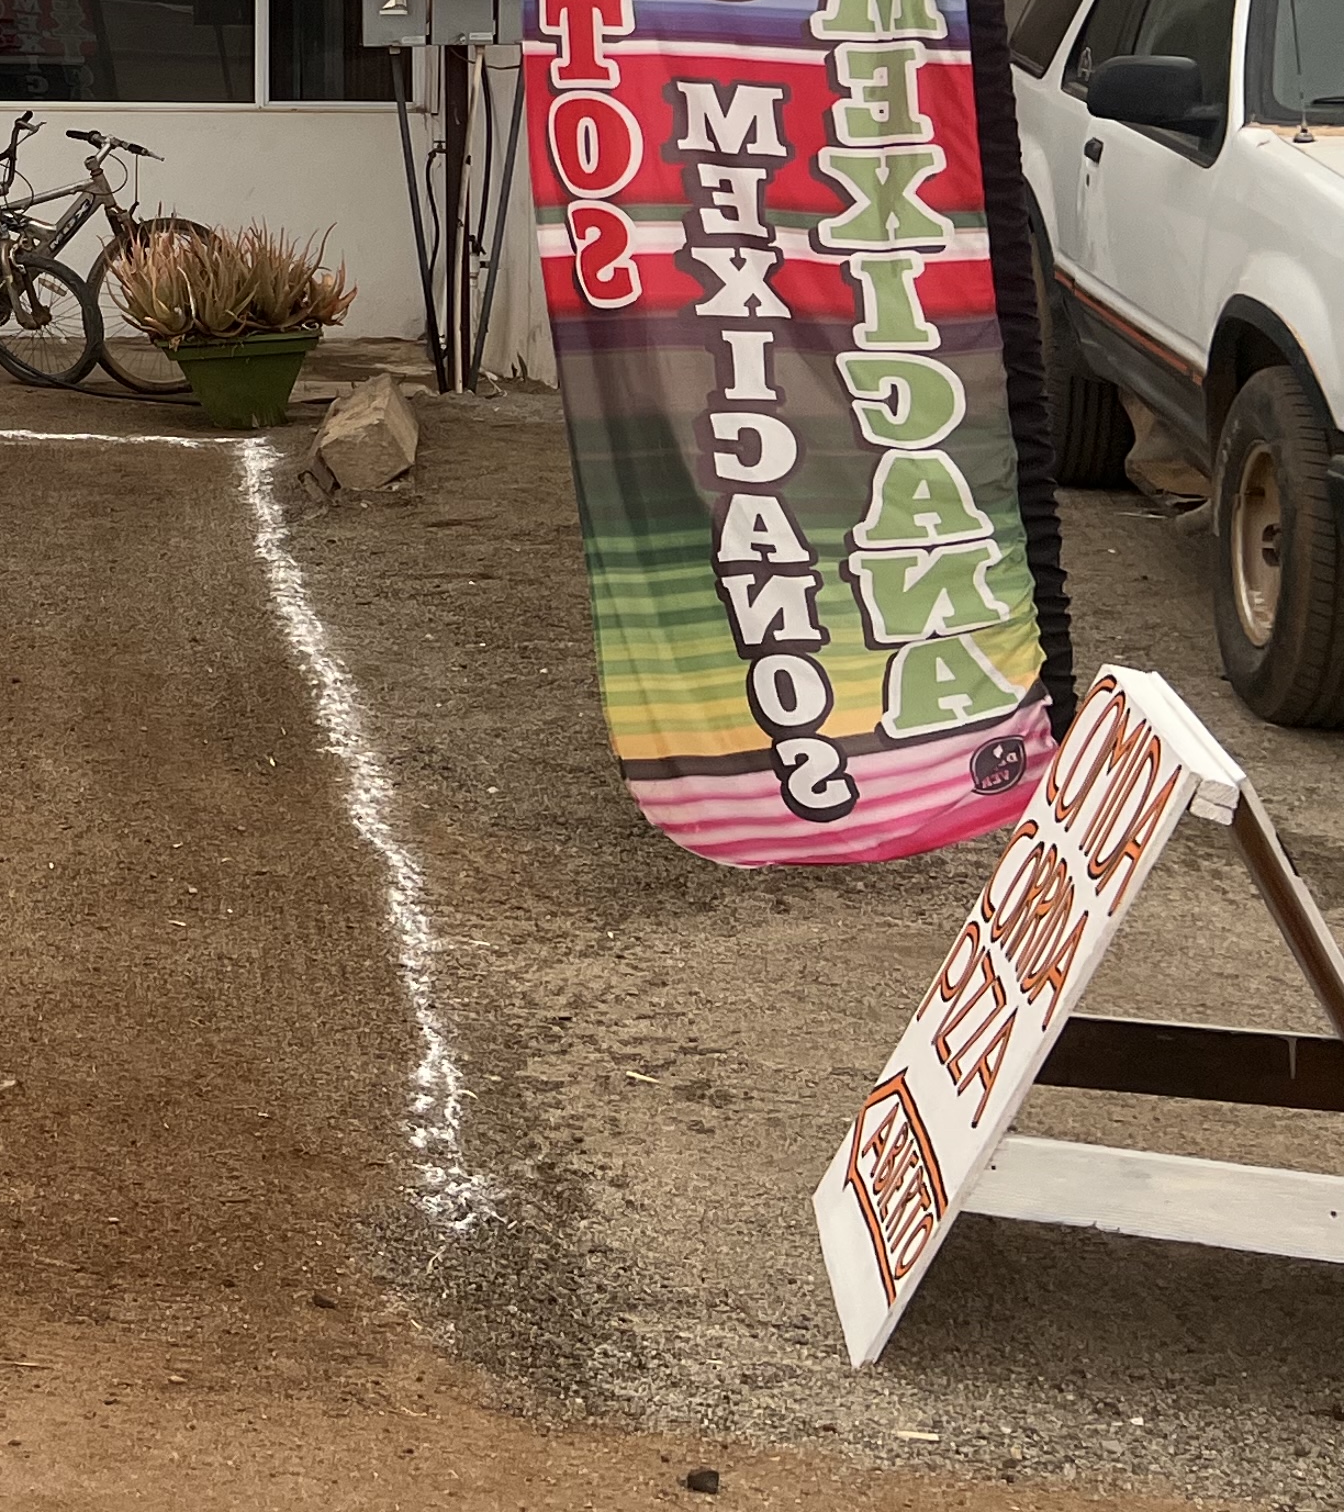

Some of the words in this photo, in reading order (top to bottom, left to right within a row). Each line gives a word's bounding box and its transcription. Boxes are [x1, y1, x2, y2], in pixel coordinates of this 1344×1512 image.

[1046, 675, 1182, 916] COMIDA
[916, 921, 1018, 1127] PIZZA
[981, 819, 1089, 1031] CORRIDA
[861, 1102, 933, 1280] ABIERTO
